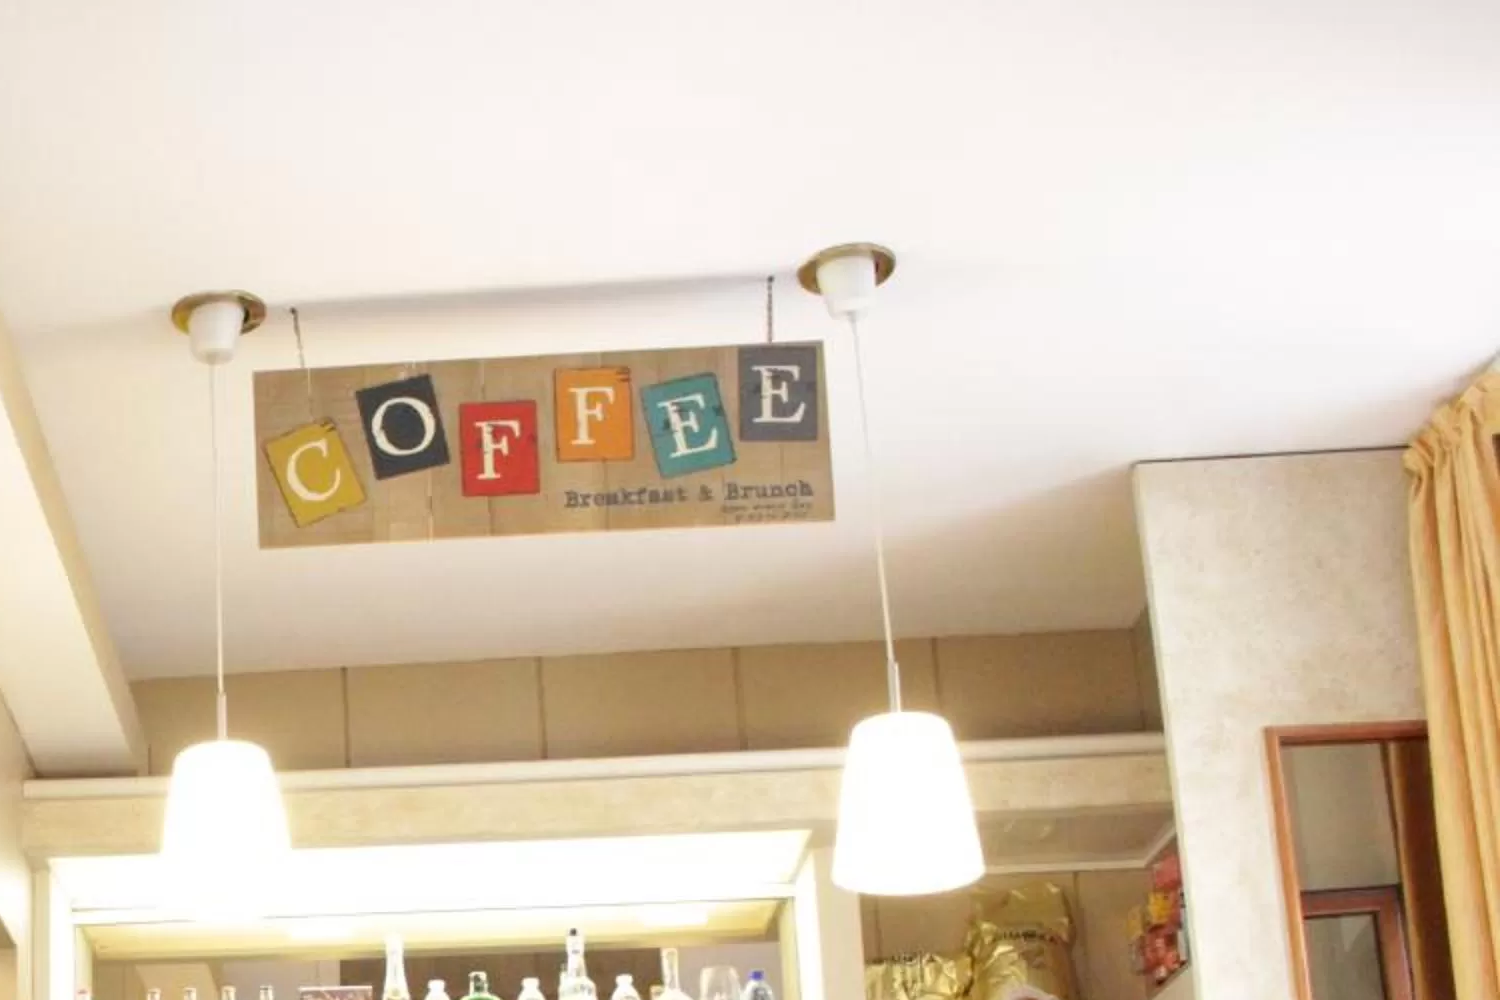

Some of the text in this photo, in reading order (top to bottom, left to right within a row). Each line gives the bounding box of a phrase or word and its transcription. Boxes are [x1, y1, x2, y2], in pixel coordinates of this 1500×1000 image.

[286, 365, 806, 502] COFFEE
[563, 480, 814, 508] Breakfast & Brunch
